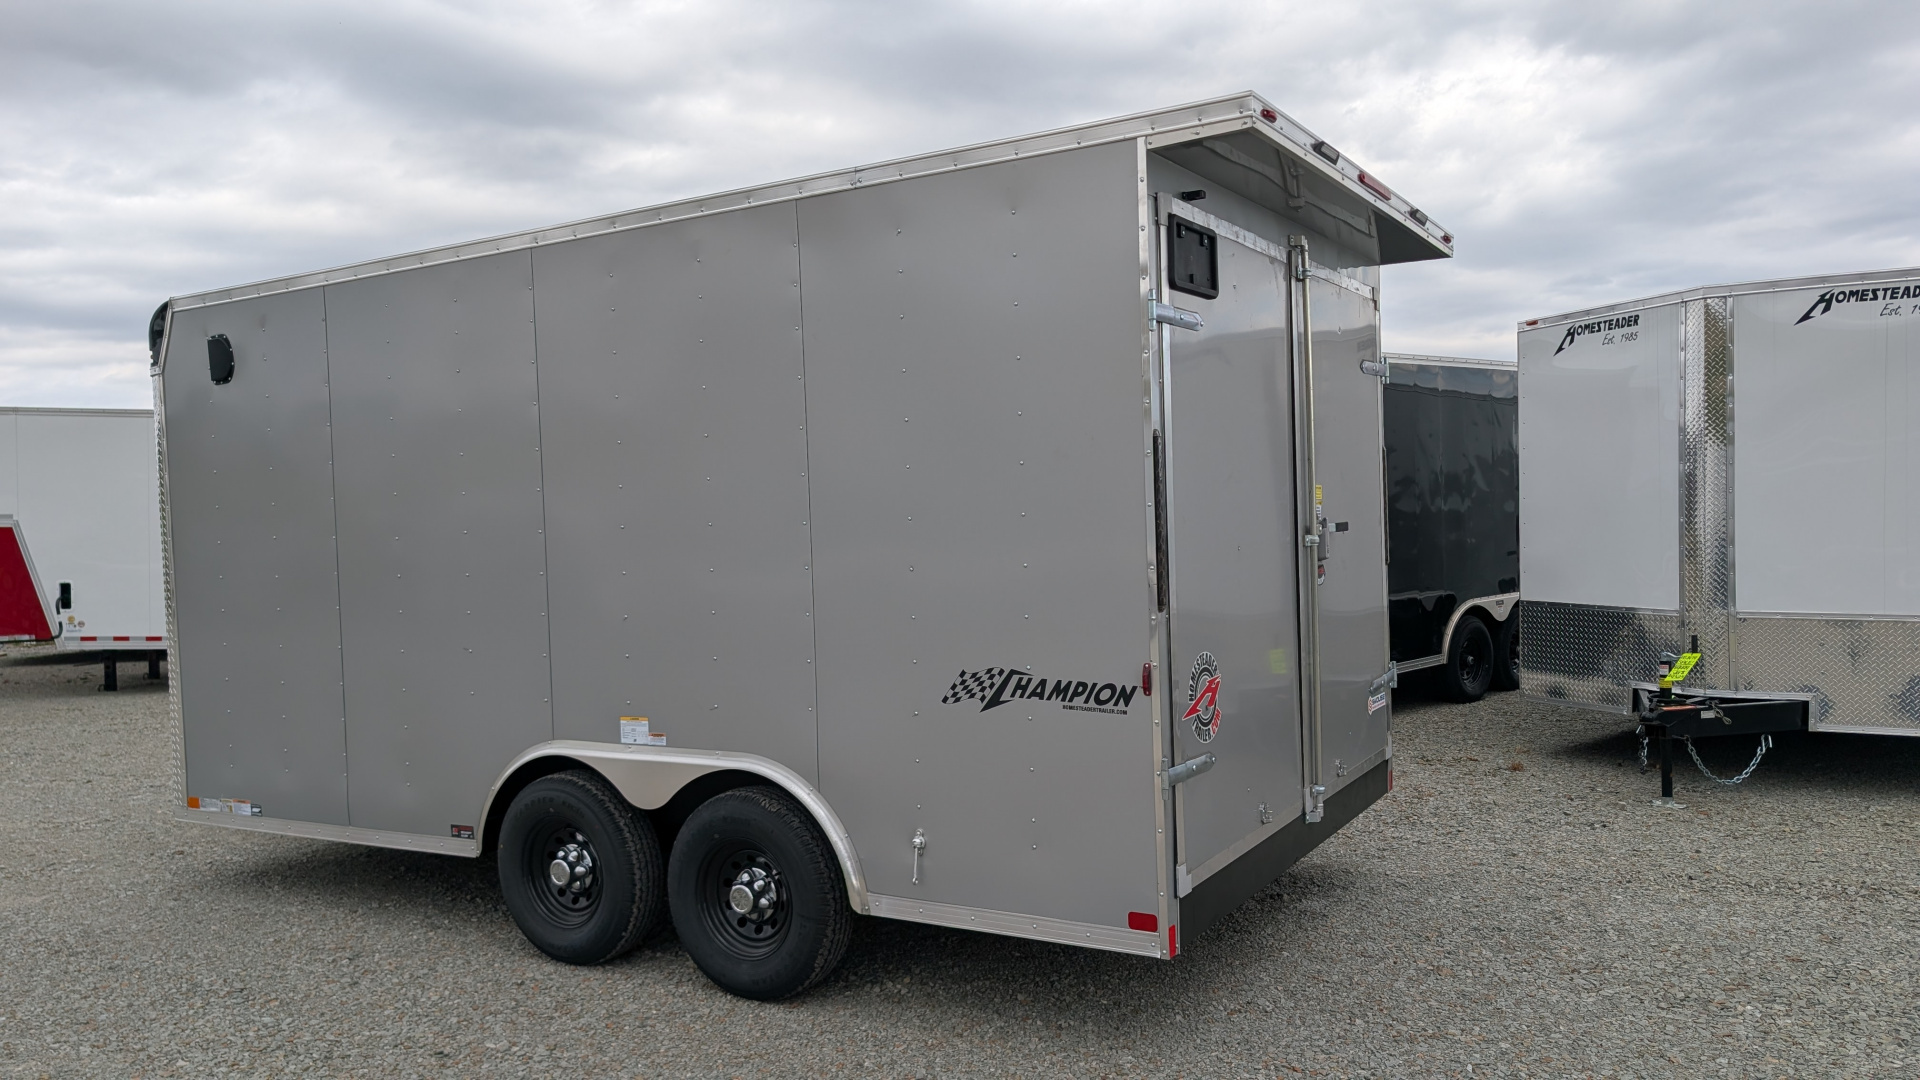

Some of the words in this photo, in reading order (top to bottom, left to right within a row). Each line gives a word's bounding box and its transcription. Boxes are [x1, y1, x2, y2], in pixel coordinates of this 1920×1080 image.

[1880, 302, 1902, 317] Est.
[1553, 314, 1640, 357] HOMESTEADER
[1602, 333, 1616, 346] Est.
[1620, 331, 1639, 343] 1985
[979, 668, 1139, 713] CHAMPION
